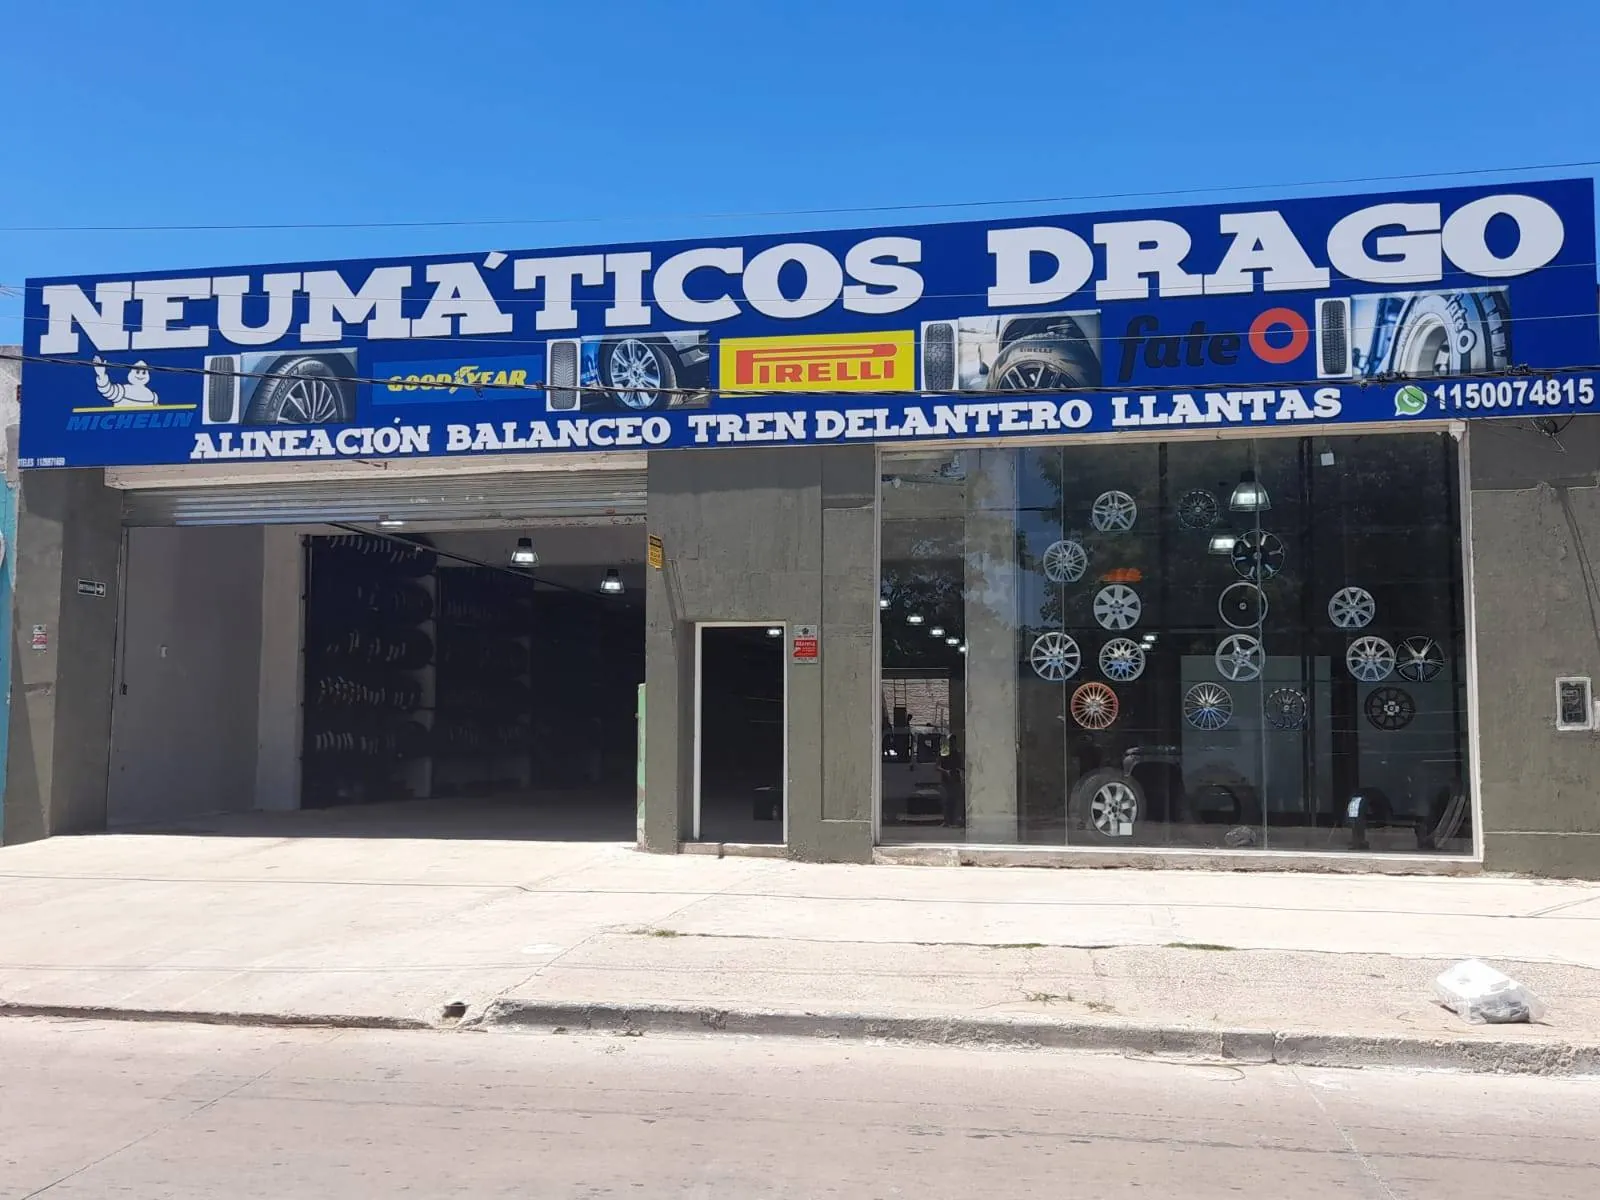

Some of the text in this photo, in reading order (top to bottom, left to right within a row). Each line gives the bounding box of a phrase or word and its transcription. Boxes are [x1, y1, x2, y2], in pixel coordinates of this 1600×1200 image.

[39, 195, 1563, 355] NEUMÁTICOS DRAGO
[736, 343, 898, 384] PIRELLI
[66, 412, 194, 431] MICHELIN
[190, 378, 1594, 459] ALINEACIÓN BALANCEO TREN DELANTERO LLANTAS 1150074815
